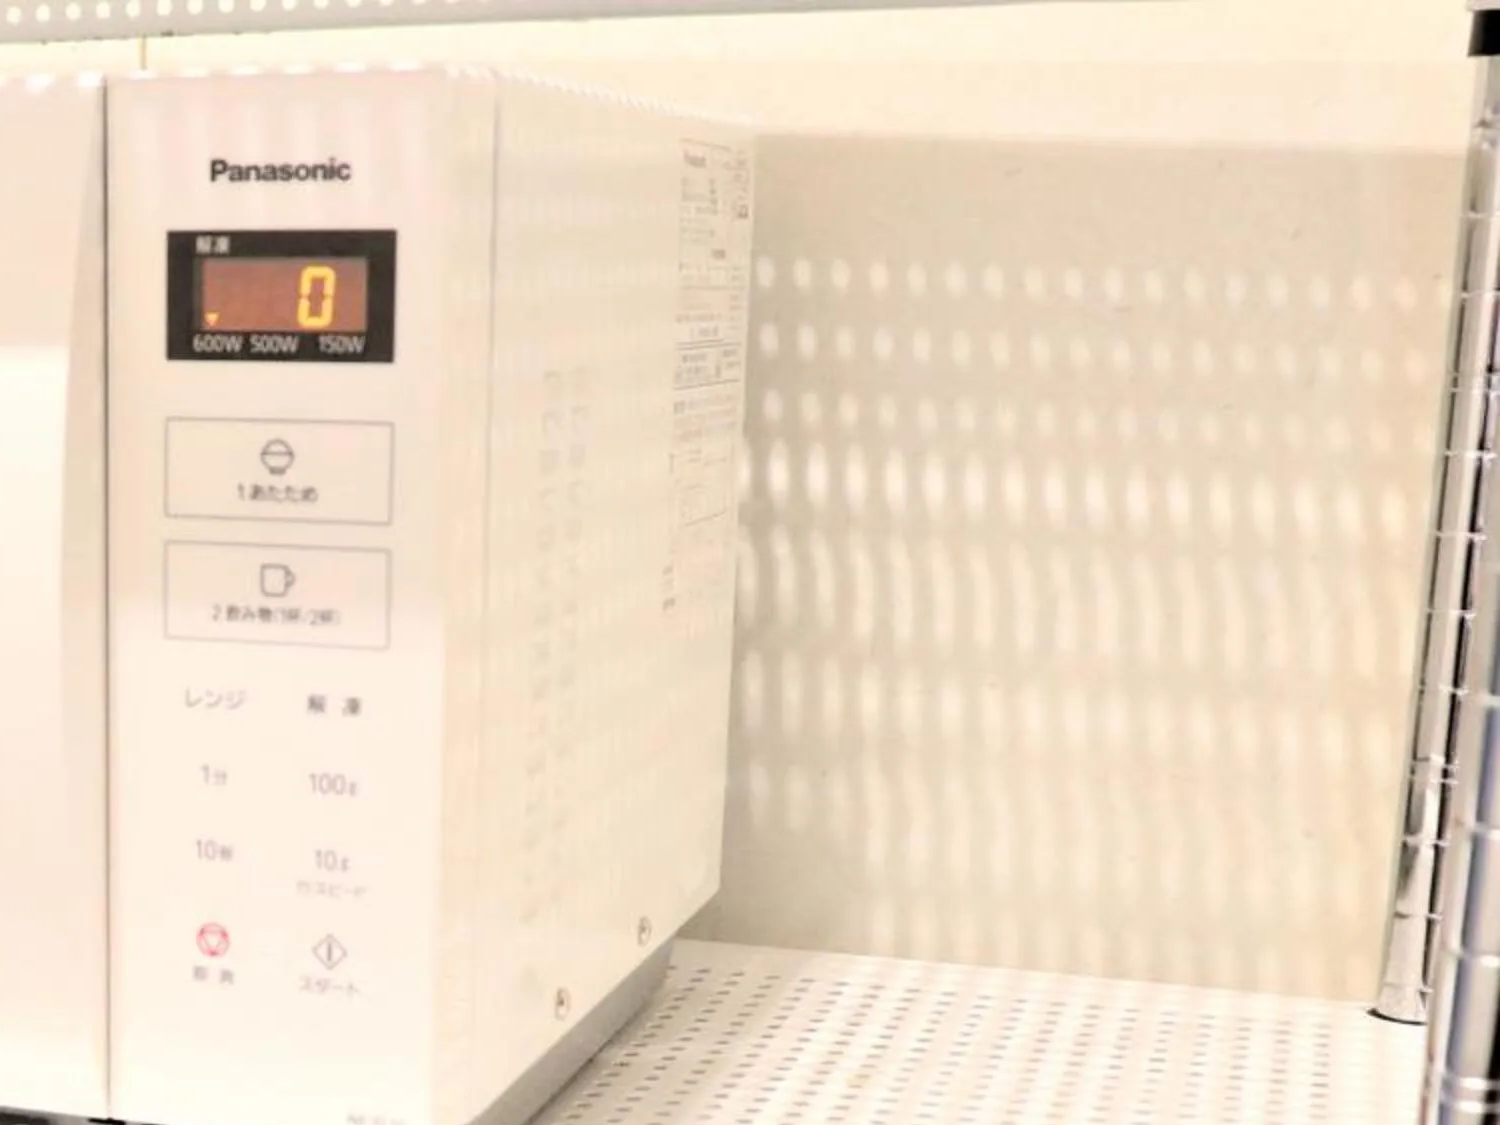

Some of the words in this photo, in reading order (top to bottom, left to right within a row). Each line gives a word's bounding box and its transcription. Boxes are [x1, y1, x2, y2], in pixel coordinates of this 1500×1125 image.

[209, 158, 352, 182] Panasonic
[298, 265, 336, 328] 0
[193, 334, 243, 353] 600W
[249, 335, 299, 354] 500W
[318, 335, 366, 354] 150W
[185, 686, 247, 710] レンジ
